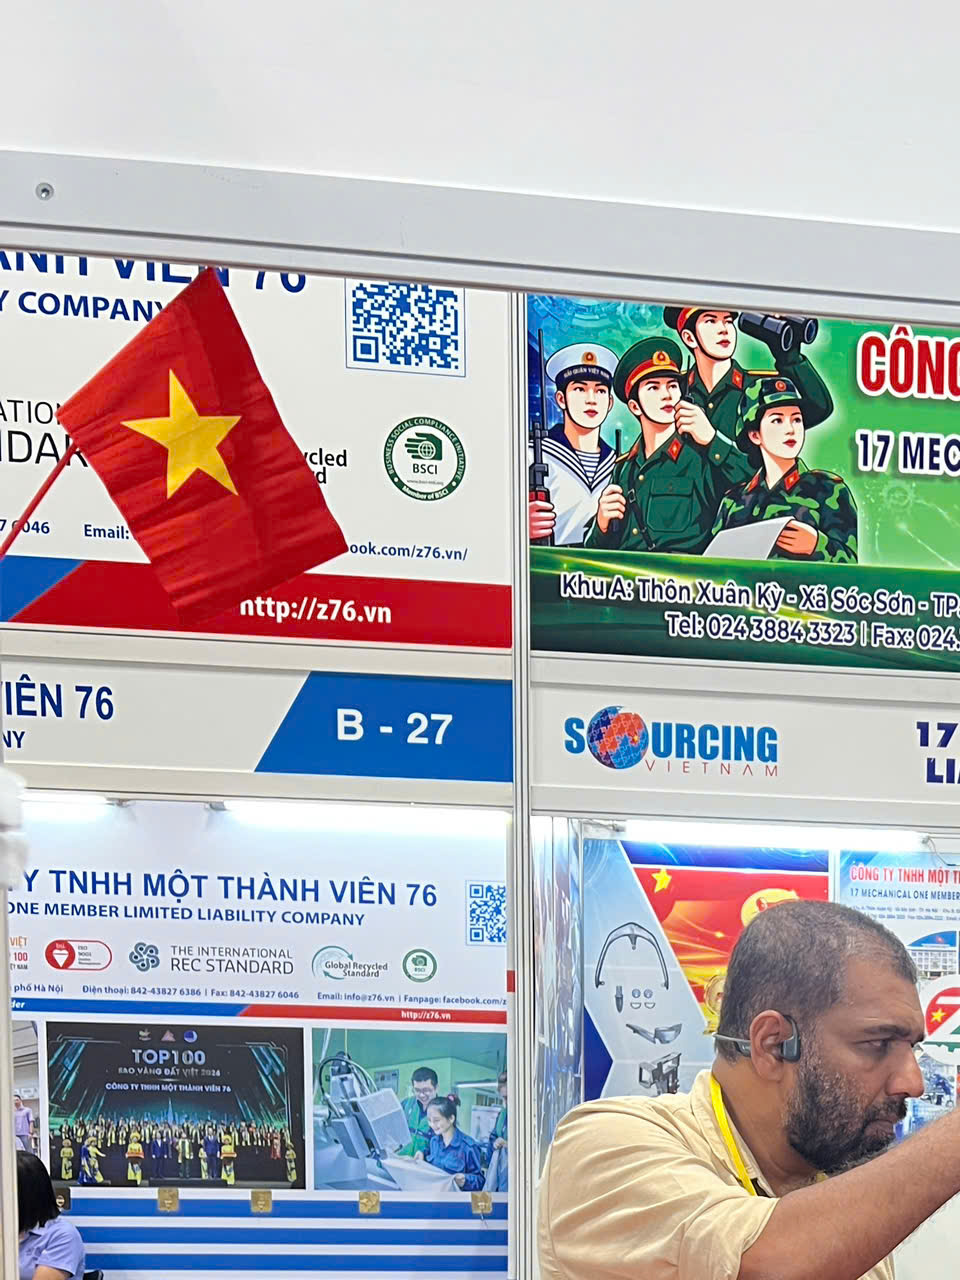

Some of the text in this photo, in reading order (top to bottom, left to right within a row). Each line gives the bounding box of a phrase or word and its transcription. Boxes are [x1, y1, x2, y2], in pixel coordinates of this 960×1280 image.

[860, 433, 891, 467] 17
[412, 463, 437, 475] BSCI
[83, 523, 130, 541] Email:
[349, 541, 468, 561] ook.com/z76.vn/
[563, 575, 605, 597] Khu
[611, 579, 631, 599] A:
[639, 577, 691, 601] Thôn
[697, 581, 749, 604] Xuân
[757, 583, 784, 610] Kỳ
[802, 585, 827, 608] Xã
[833, 587, 870, 613] Sóc
[879, 592, 914, 614] Sơn
[240, 597, 392, 624] http://z76.vn
[667, 613, 705, 635] Tel:
[874, 625, 913, 648] Fax:
[4, 674, 115, 720] IÊN 76
[336, 709, 453, 745] B 27
[917, 721, 958, 748] 17
[645, 760, 779, 778] VIETNAM
[49, 868, 438, 907] TNHH MỘT THÀNH VIÊN 76
[850, 864, 878, 882] CÔNG
[883, 868, 893, 882] TY
[898, 868, 924, 884] TNHH
[928, 866, 949, 888] MỘT
[44, 902, 365, 926] MEMBER LIMITED LIABILITY COMPANY
[171, 945, 293, 960] THE INTERNATIONAL
[170, 958, 294, 977] REC STANDARD
[325, 959, 388, 973] Global Recycled
[343, 968, 380, 978] Standard
[132, 1049, 206, 1066] TOP100
